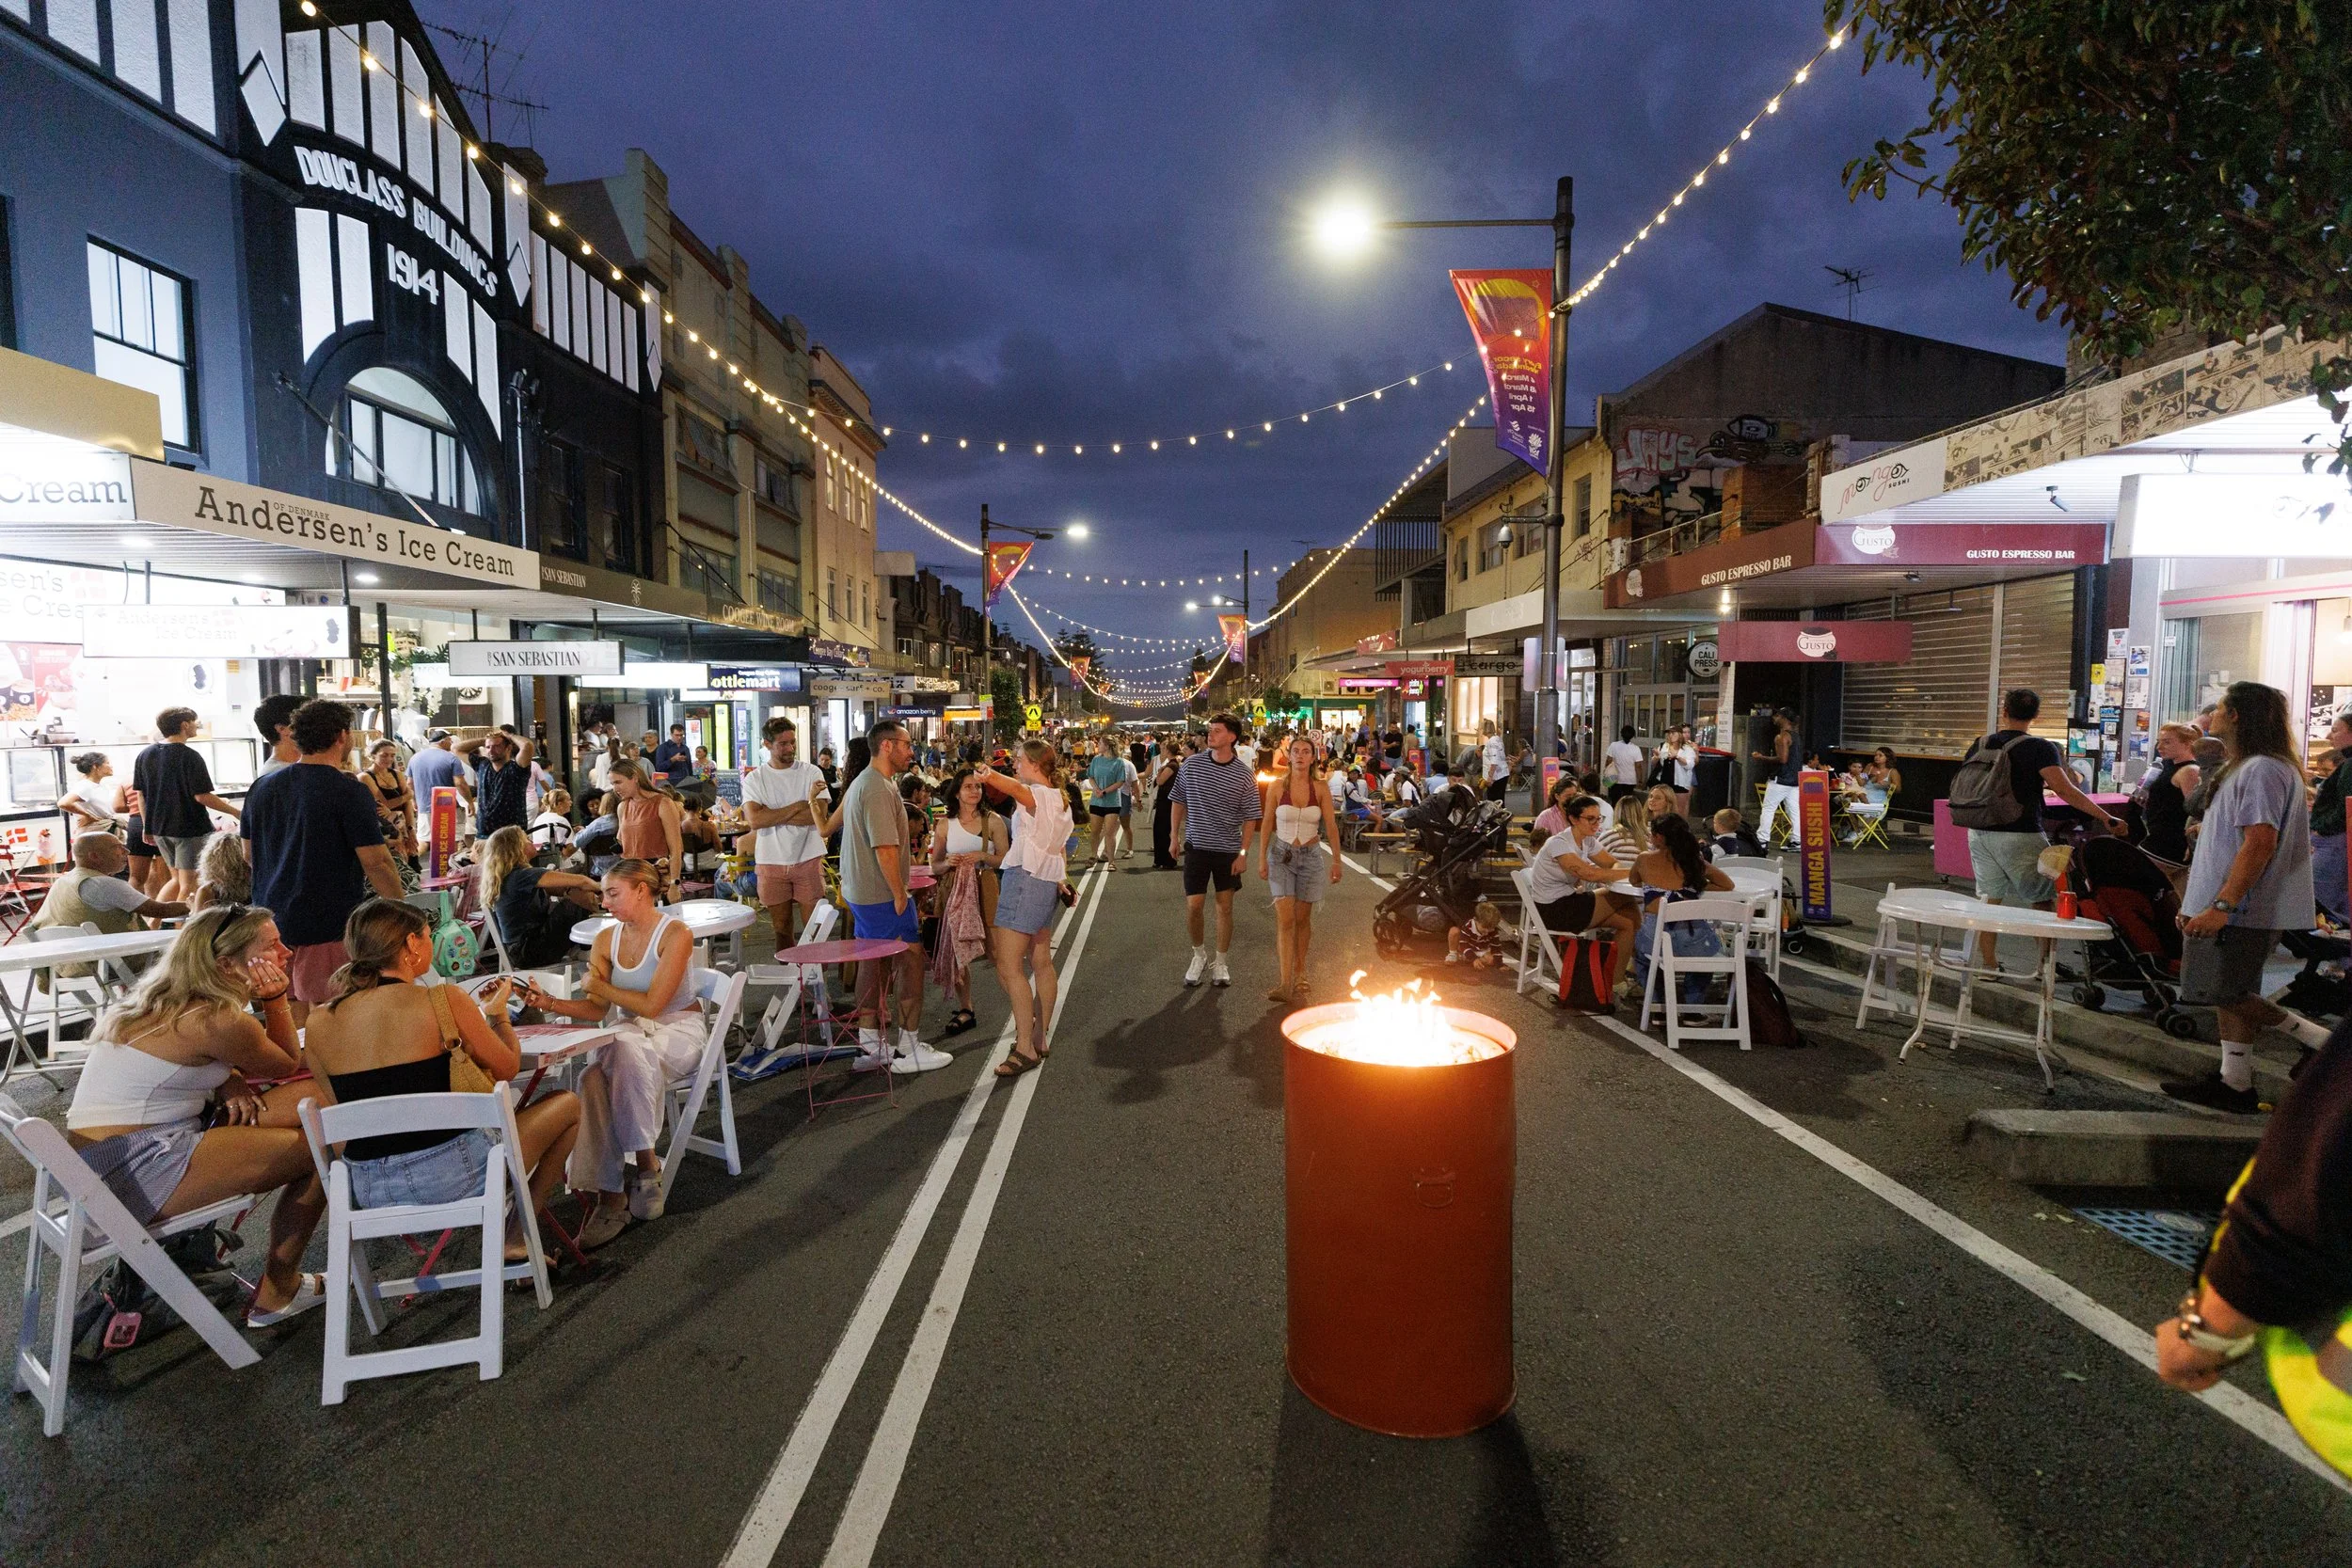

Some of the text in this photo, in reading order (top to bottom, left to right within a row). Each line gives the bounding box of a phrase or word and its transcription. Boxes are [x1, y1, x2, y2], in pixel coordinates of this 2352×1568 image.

[294, 145, 498, 297] DOUGLASS BUILDINGS
[387, 243, 439, 306] 1914
[0, 473, 128, 503] Cream
[1888, 478, 1910, 488] SUSHI
[274, 501, 330, 521] OF DENMARK
[195, 485, 515, 577] Andersen's Ice Cream
[1853, 532, 1893, 546] GUSTO
[1966, 549, 2075, 559] GUSTO ESPRESSO BAR
[545, 567, 586, 588] SAN SEBASTIAN
[1701, 555, 1791, 585] GUSTO ESPRESSO BAR
[23, 594, 85, 619] Crea
[1798, 637, 1835, 650] GUSTO
[493, 651, 580, 667] SAN SEBASTIAN
[1694, 659, 1718, 668] PRESS
[1698, 651, 1715, 659] CALI
[1470, 660, 1516, 673] cargo
[711, 674, 780, 689] ottlemart
[920, 707, 936, 716] berry
[439, 813, 449, 839] CREAM
[1806, 801, 1824, 847] SUSHI
[439, 840, 448, 852] ICE
[1808, 850, 1826, 906] MANGA
